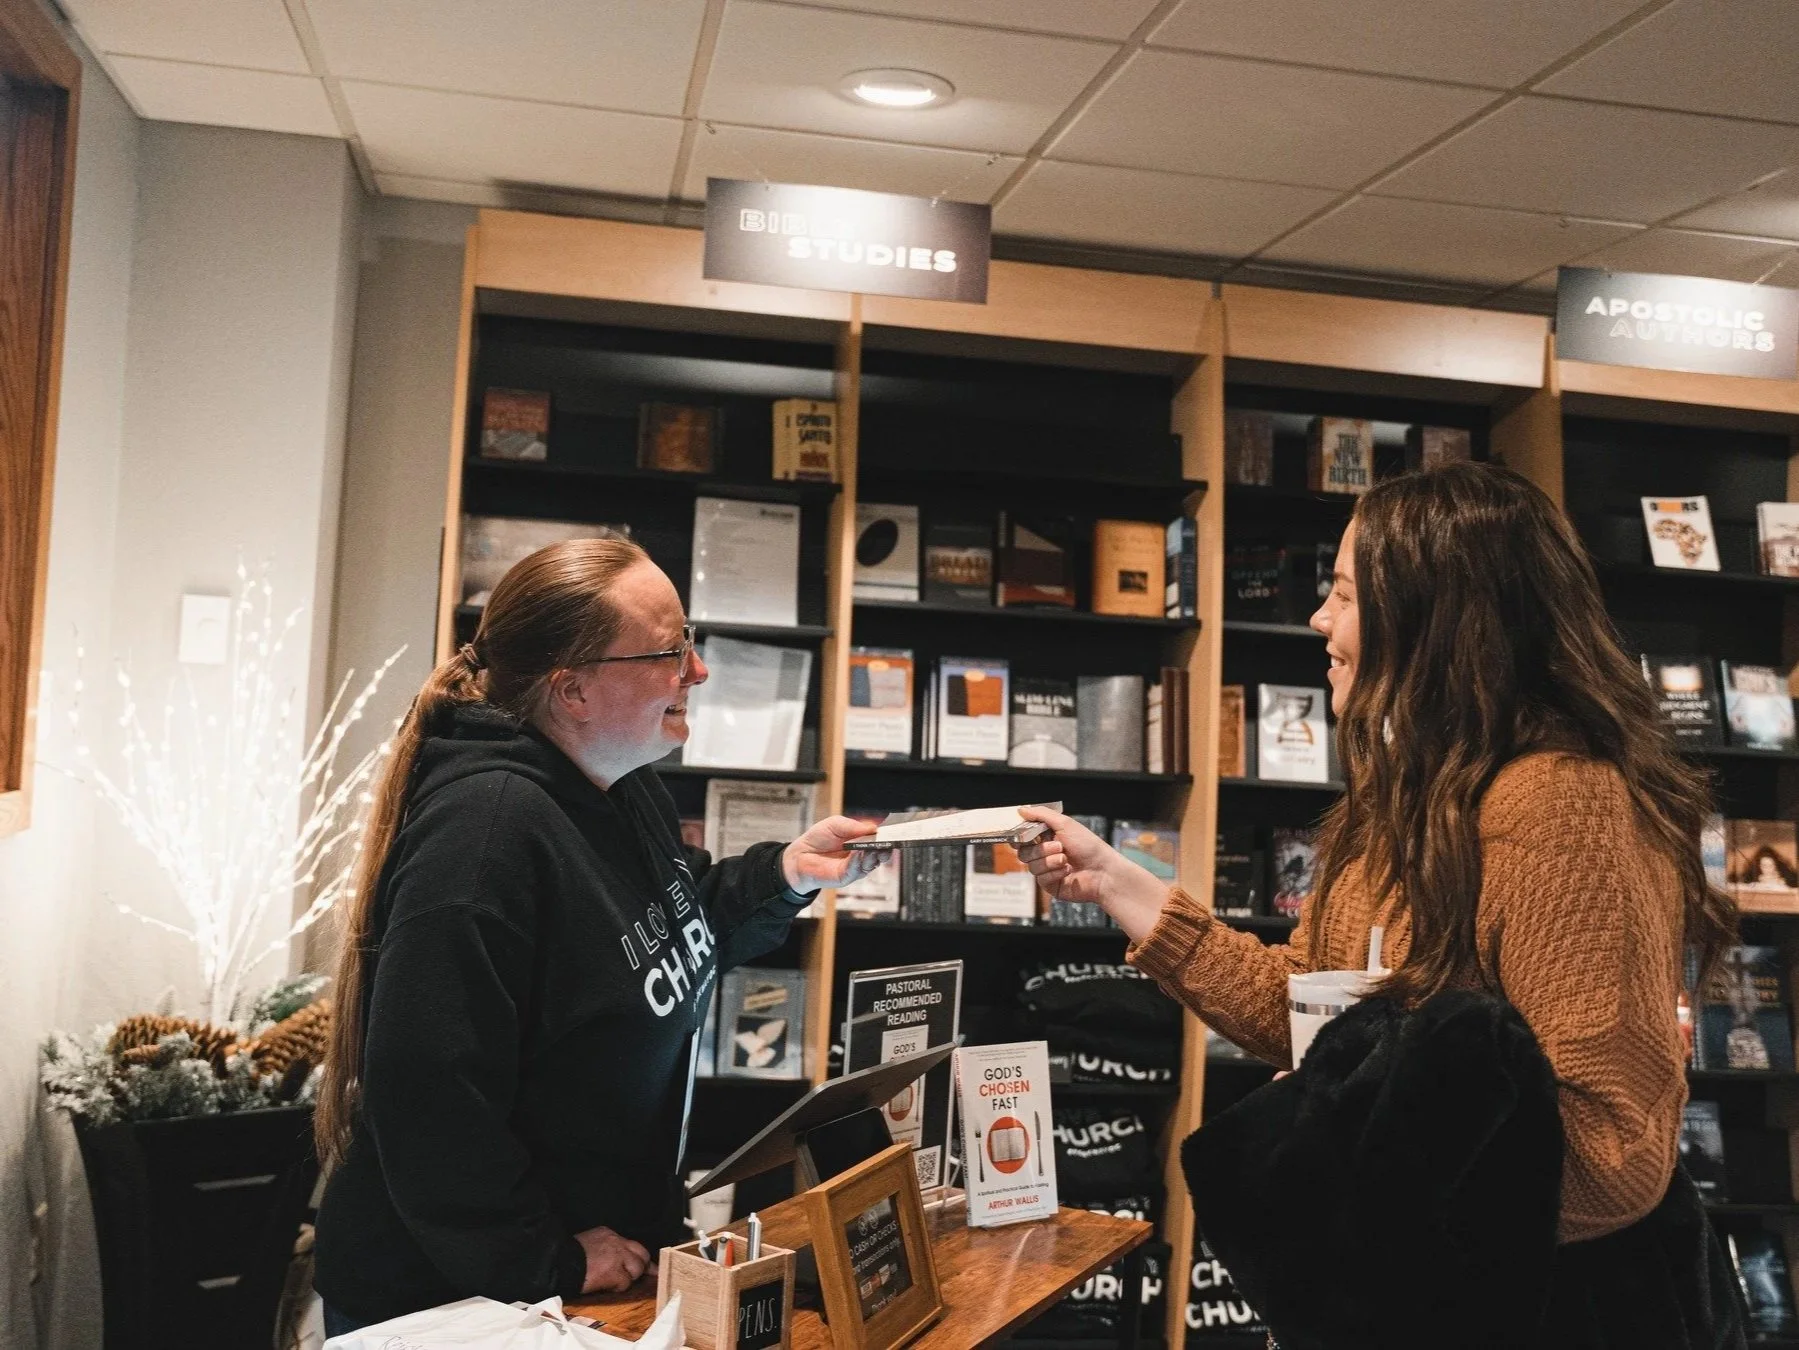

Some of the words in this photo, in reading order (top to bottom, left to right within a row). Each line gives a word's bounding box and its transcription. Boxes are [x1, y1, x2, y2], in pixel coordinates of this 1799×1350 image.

[788, 236, 957, 273] STUDIES
[1585, 296, 1764, 331] APOSTOLIC
[1609, 318, 1775, 352] AUTHORS
[1339, 433, 1359, 450] THE
[1329, 465, 1366, 485] BIRTH
[620, 934, 640, 970] I
[886, 979, 932, 995] PASTORAL
[1024, 963, 1151, 991] CHURC
[873, 992, 942, 1013] RECOMMENDED
[887, 1009, 927, 1026] READING
[893, 1042, 916, 1055] GOD'S
[984, 1066, 1022, 1080] GOD'S
[979, 1080, 1030, 1097] CHOSEN
[992, 1096, 1018, 1110] FAST
[1053, 1116, 1144, 1146] HURC
[988, 1199, 1013, 1210] ARTHUR
[1015, 1195, 1039, 1205] WALLIS
[1185, 1300, 1261, 1329] CHU
